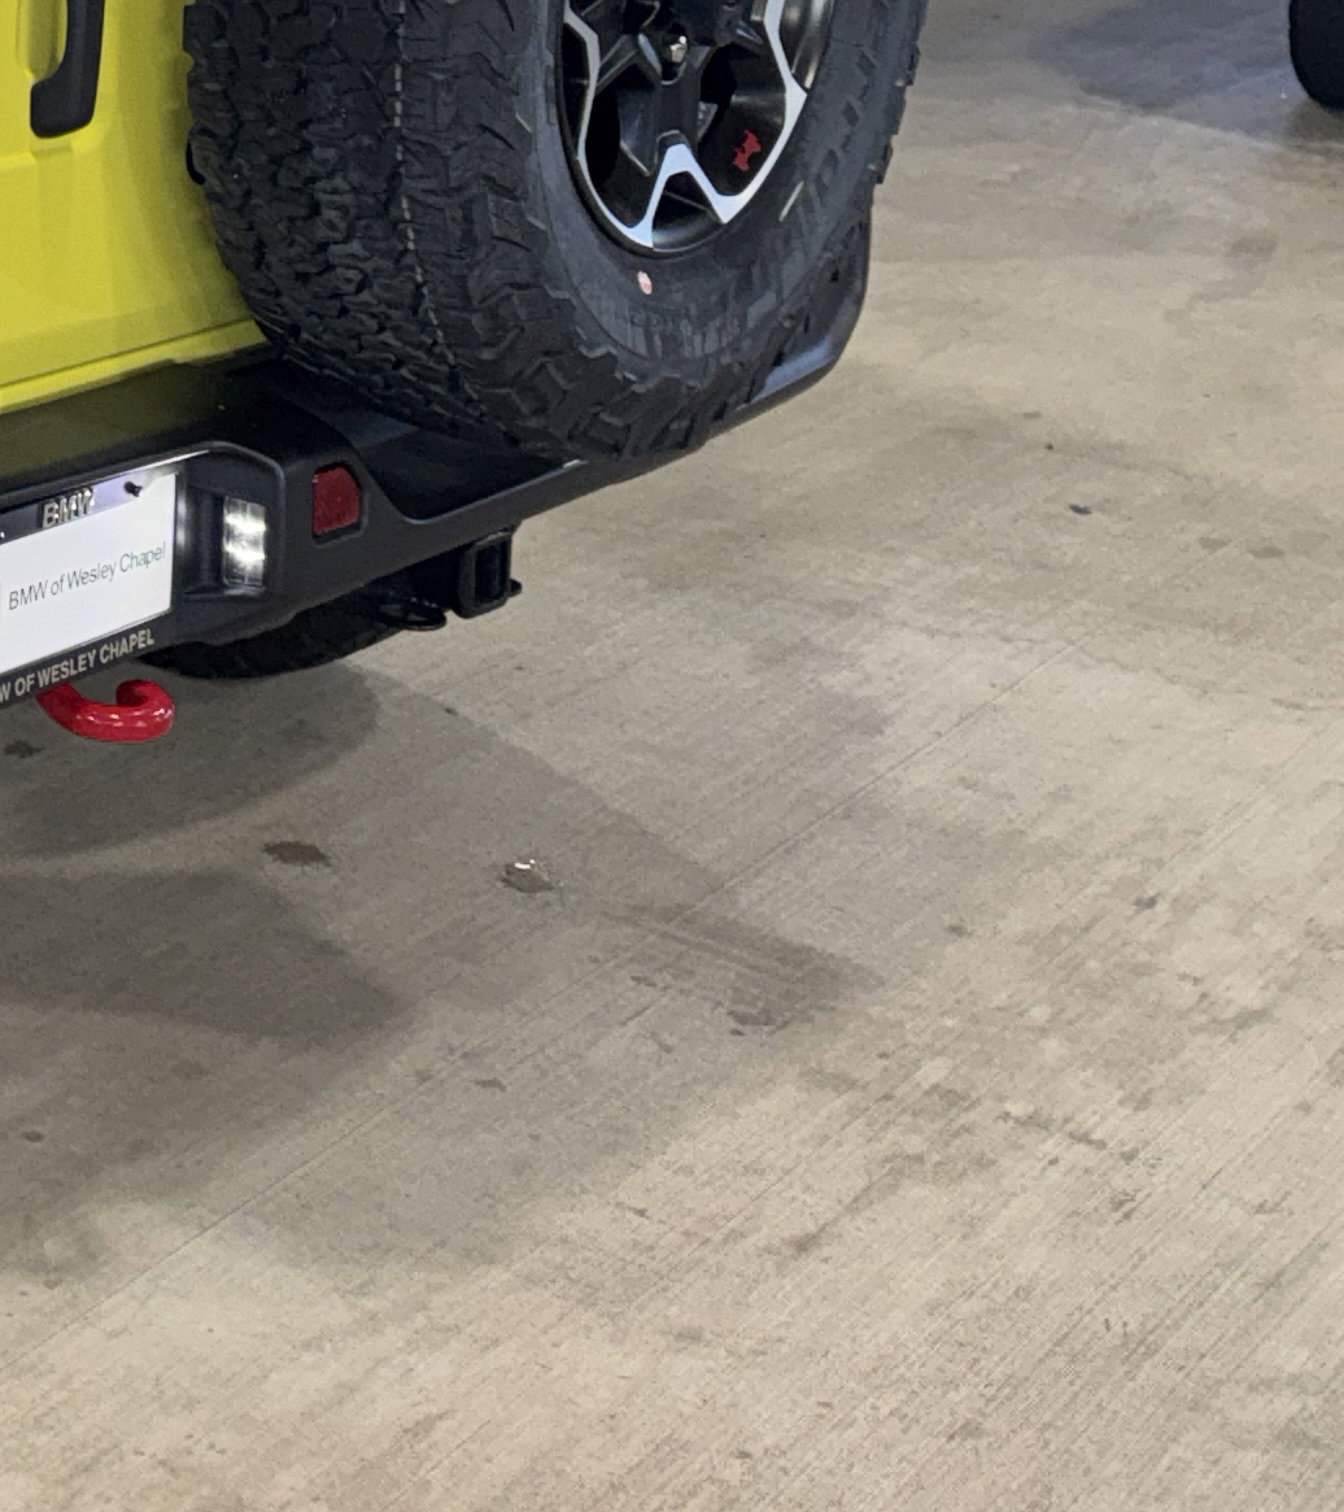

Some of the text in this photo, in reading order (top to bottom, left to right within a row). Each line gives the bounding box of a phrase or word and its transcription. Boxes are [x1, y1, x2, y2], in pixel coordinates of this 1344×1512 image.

[42, 487, 97, 529] BMW
[9, 541, 166, 610] BMW of Wesley Chapel
[14, 672, 36, 696] OF
[37, 648, 97, 688] WESLEY
[99, 628, 155, 663] CHAPEL
